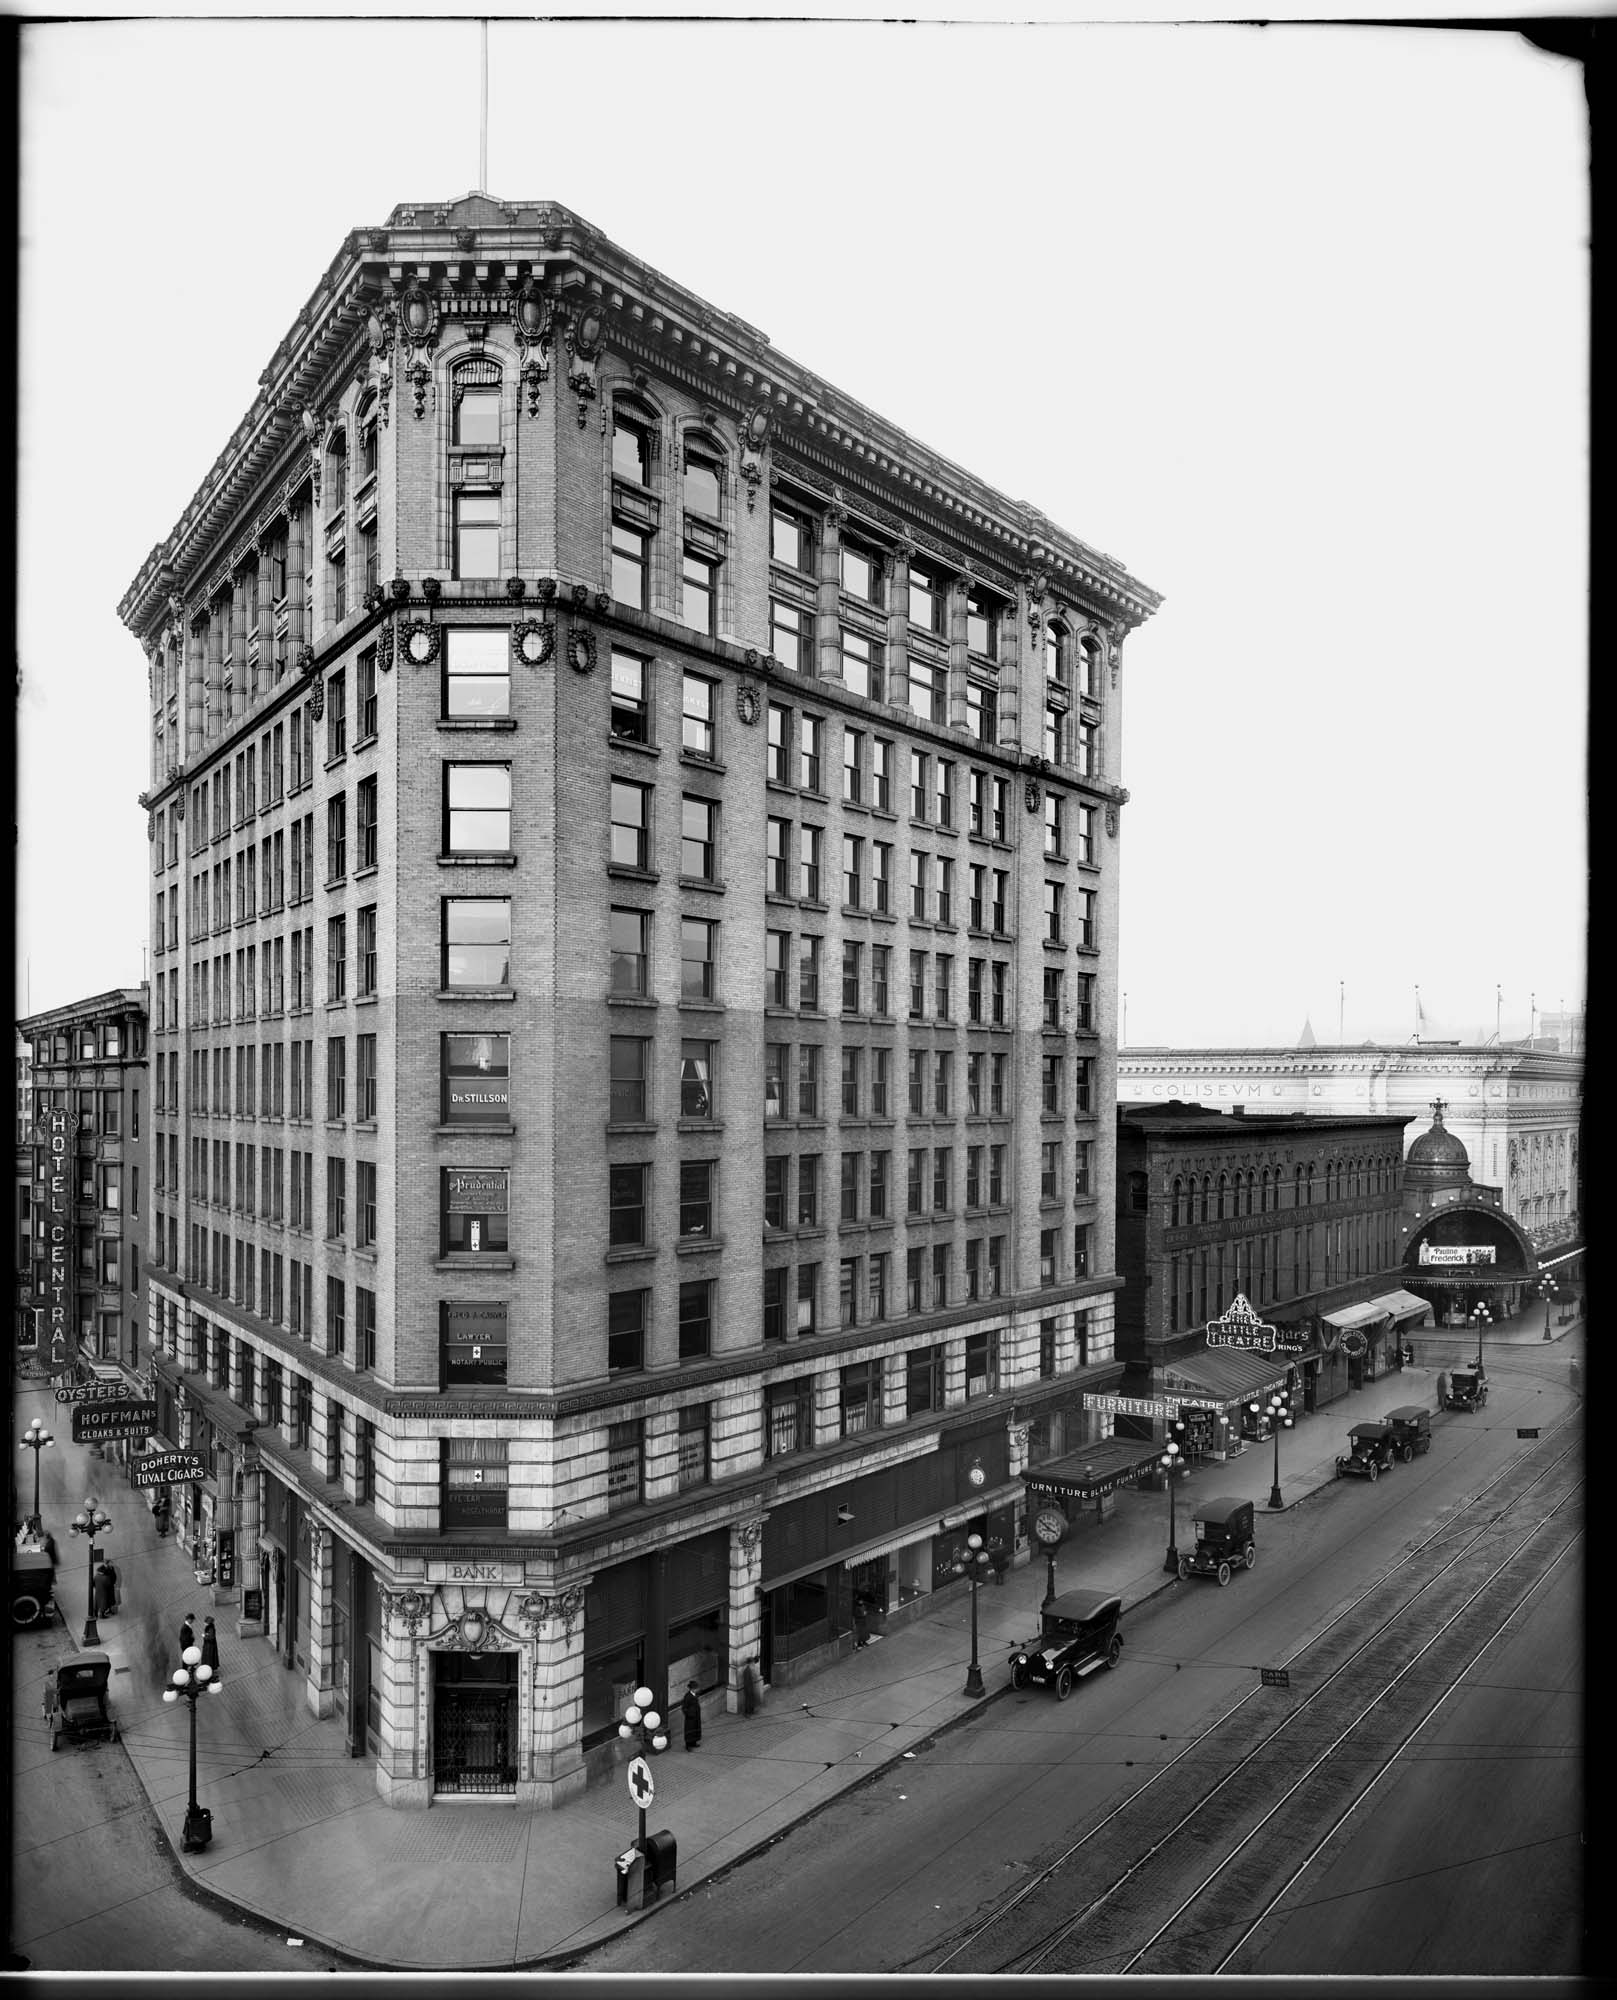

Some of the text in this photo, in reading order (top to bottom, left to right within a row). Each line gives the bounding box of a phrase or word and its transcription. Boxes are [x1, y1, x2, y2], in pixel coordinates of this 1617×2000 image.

[465, 1093, 508, 1103] STILLSON
[1152, 1084, 1261, 1097] COLISEVM
[52, 1116, 65, 1212] HOTEL
[457, 1178, 506, 1193] Prudential
[1431, 1254, 1465, 1263] Frederick
[1433, 1247, 1458, 1255] Pauline
[51, 1226, 66, 1363] CENTRAL
[1232, 1314, 1250, 1324] THE
[1221, 1324, 1259, 1336] LITTLE
[1211, 1331, 1272, 1348] THEATRE
[57, 1384, 128, 1401] OYSTERS
[1243, 1389, 1260, 1402] LITTLE
[1263, 1379, 1284, 1393] THEATRE
[1087, 1396, 1175, 1419] FURNITURE
[1164, 1396, 1224, 1410] THEATRE
[81, 1429, 113, 1439] CLOAKS
[125, 1427, 150, 1436] SUITS
[141, 1455, 199, 1472] DOHERTY'S
[136, 1467, 204, 1485] TUVAL CIGARS
[1089, 1463, 1153, 1498] BLAKE FURNITURE
[453, 1566, 497, 1580] BANK
